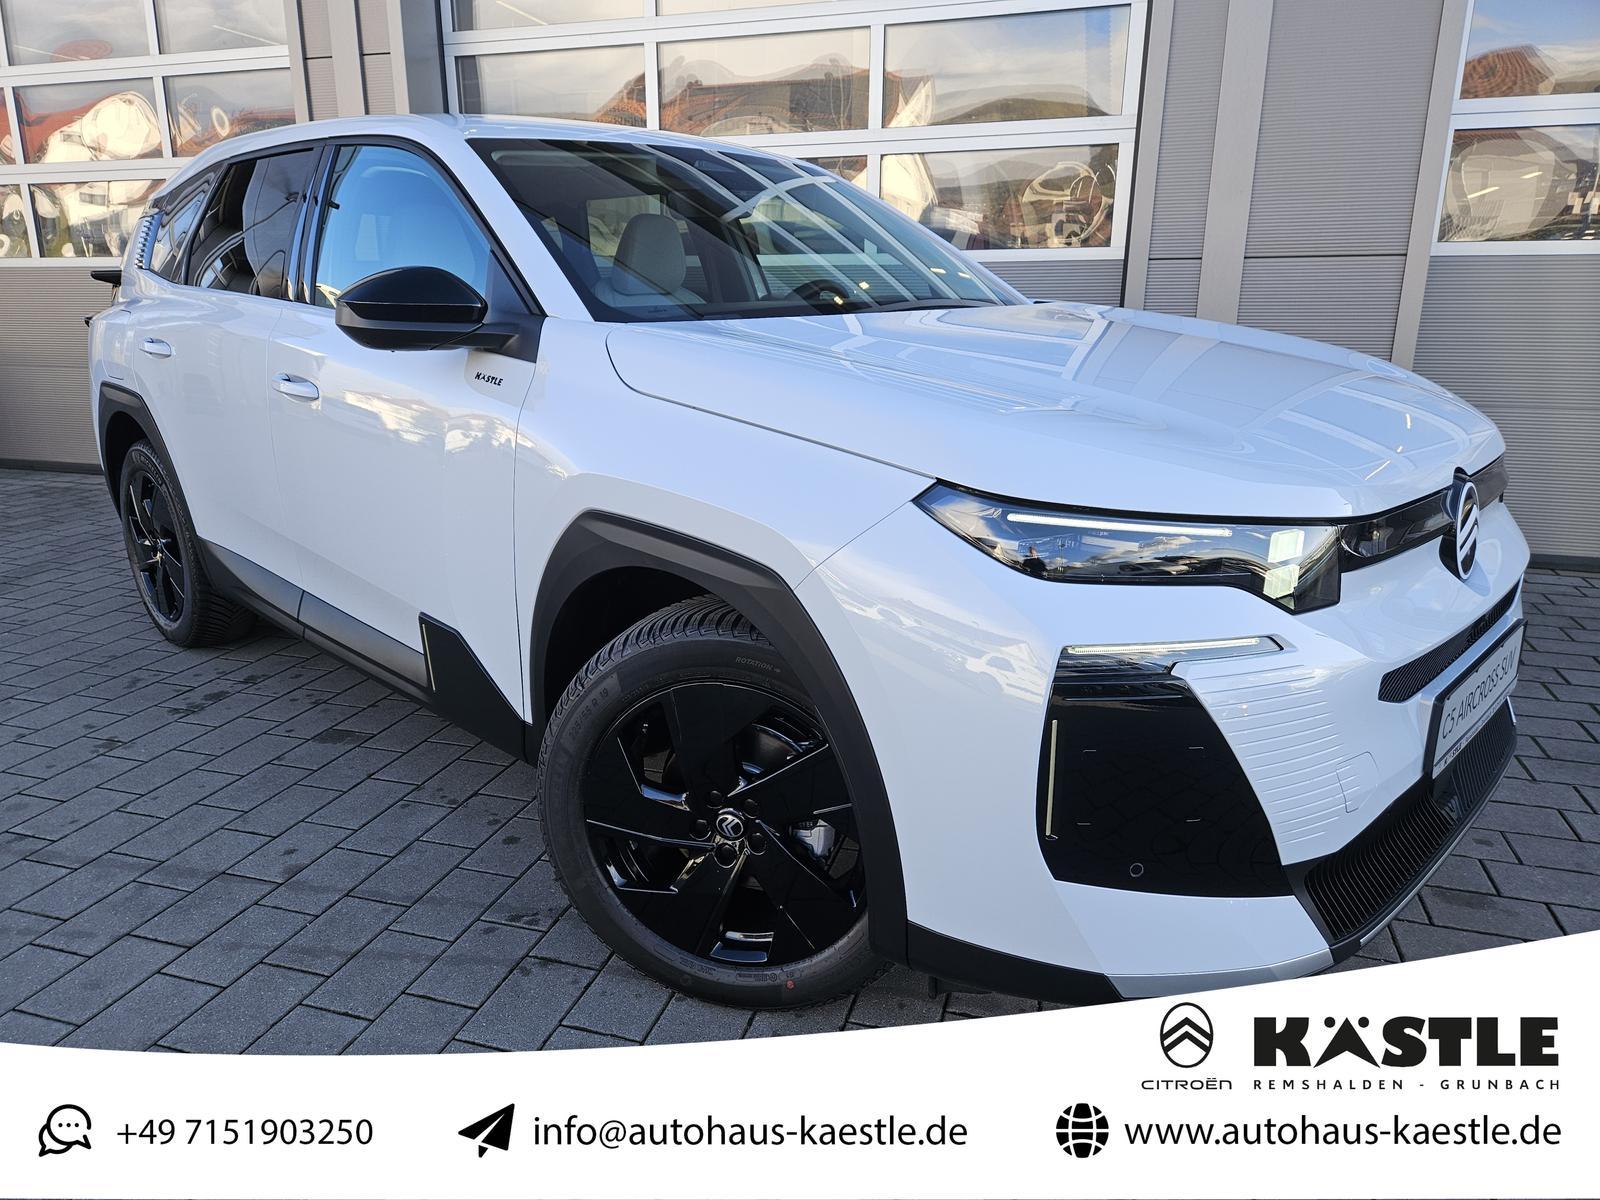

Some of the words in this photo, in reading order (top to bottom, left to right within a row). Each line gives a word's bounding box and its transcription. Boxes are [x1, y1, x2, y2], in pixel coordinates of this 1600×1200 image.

[1443, 707, 1456, 739] C5
[1456, 664, 1500, 724] AIRCROSS
[1500, 645, 1517, 681] SUV
